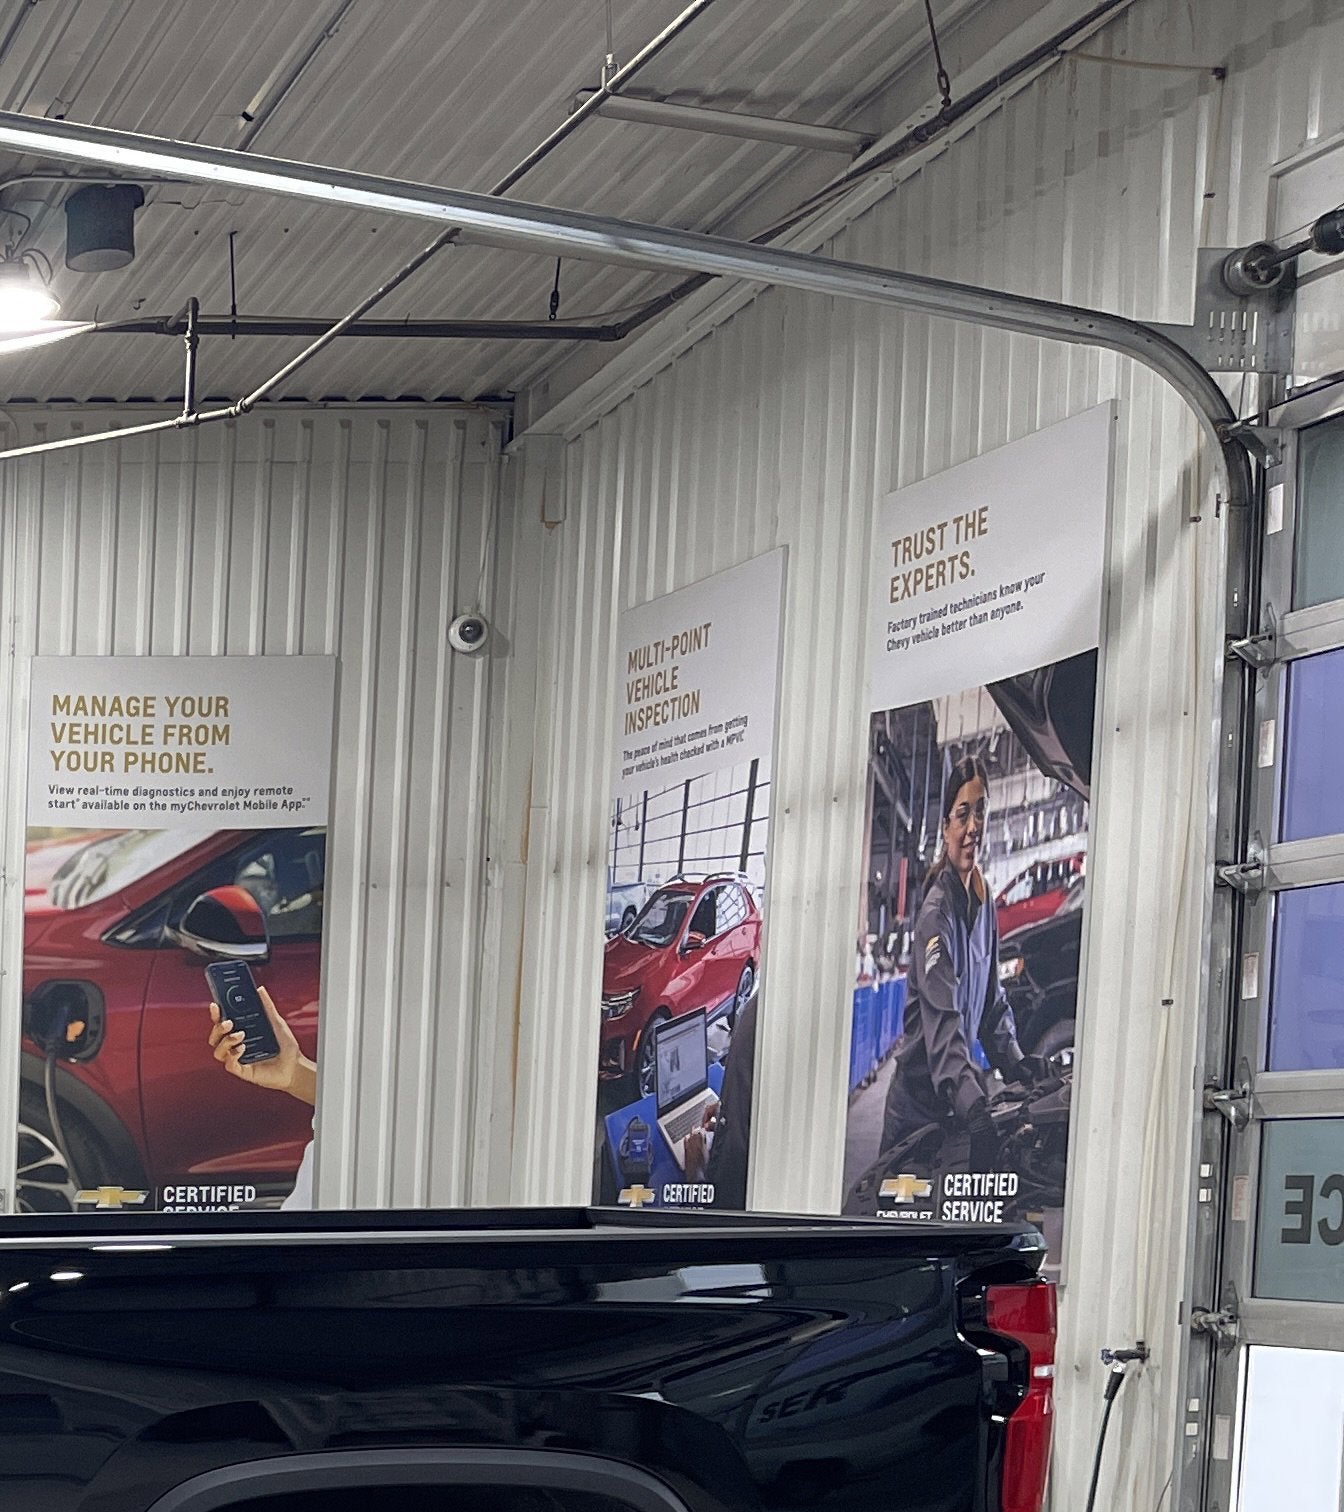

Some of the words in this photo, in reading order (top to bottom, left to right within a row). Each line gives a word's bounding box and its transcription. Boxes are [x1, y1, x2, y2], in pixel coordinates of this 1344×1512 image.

[891, 521, 948, 567] TRUST
[953, 506, 989, 544] THE
[890, 551, 975, 603] EXPERTS.
[887, 615, 917, 634] Factory
[919, 604, 948, 624] trained
[949, 589, 997, 614] technicians
[999, 579, 1022, 597] know
[1024, 572, 1046, 592] your
[886, 634, 909, 651] Chevy
[912, 623, 939, 645] vehicle
[941, 616, 968, 636] better
[969, 611, 988, 626] than
[990, 601, 1023, 621] anyone.
[628, 622, 712, 674] MULTI-POINT
[626, 666, 679, 705] VEHICLE
[52, 694, 157, 717] MANAGE
[164, 695, 230, 718] YOUR
[625, 689, 700, 736] INSPECTION
[50, 722, 155, 745] VEHICLE
[162, 723, 230, 746] FROM
[50, 750, 114, 773] YOUR
[123, 751, 213, 774] PHONE.
[47, 784, 74, 795] View
[77, 785, 129, 796] real-time
[132, 786, 195, 798] diagnostics
[198, 786, 218, 797] and
[221, 787, 250, 798] enjoy
[253, 786, 293, 796] remote
[81, 799, 129, 810] available
[132, 802, 146, 810] on
[149, 800, 167, 811] the
[170, 800, 240, 813] myChevrolet
[243, 799, 278, 810] Mobile
[163, 1186, 256, 1203] CERTIFIED
[663, 1184, 715, 1203] CERTIFIED
[944, 1173, 1018, 1196] CERTIFIED
[942, 1201, 1004, 1223] SERVICE
